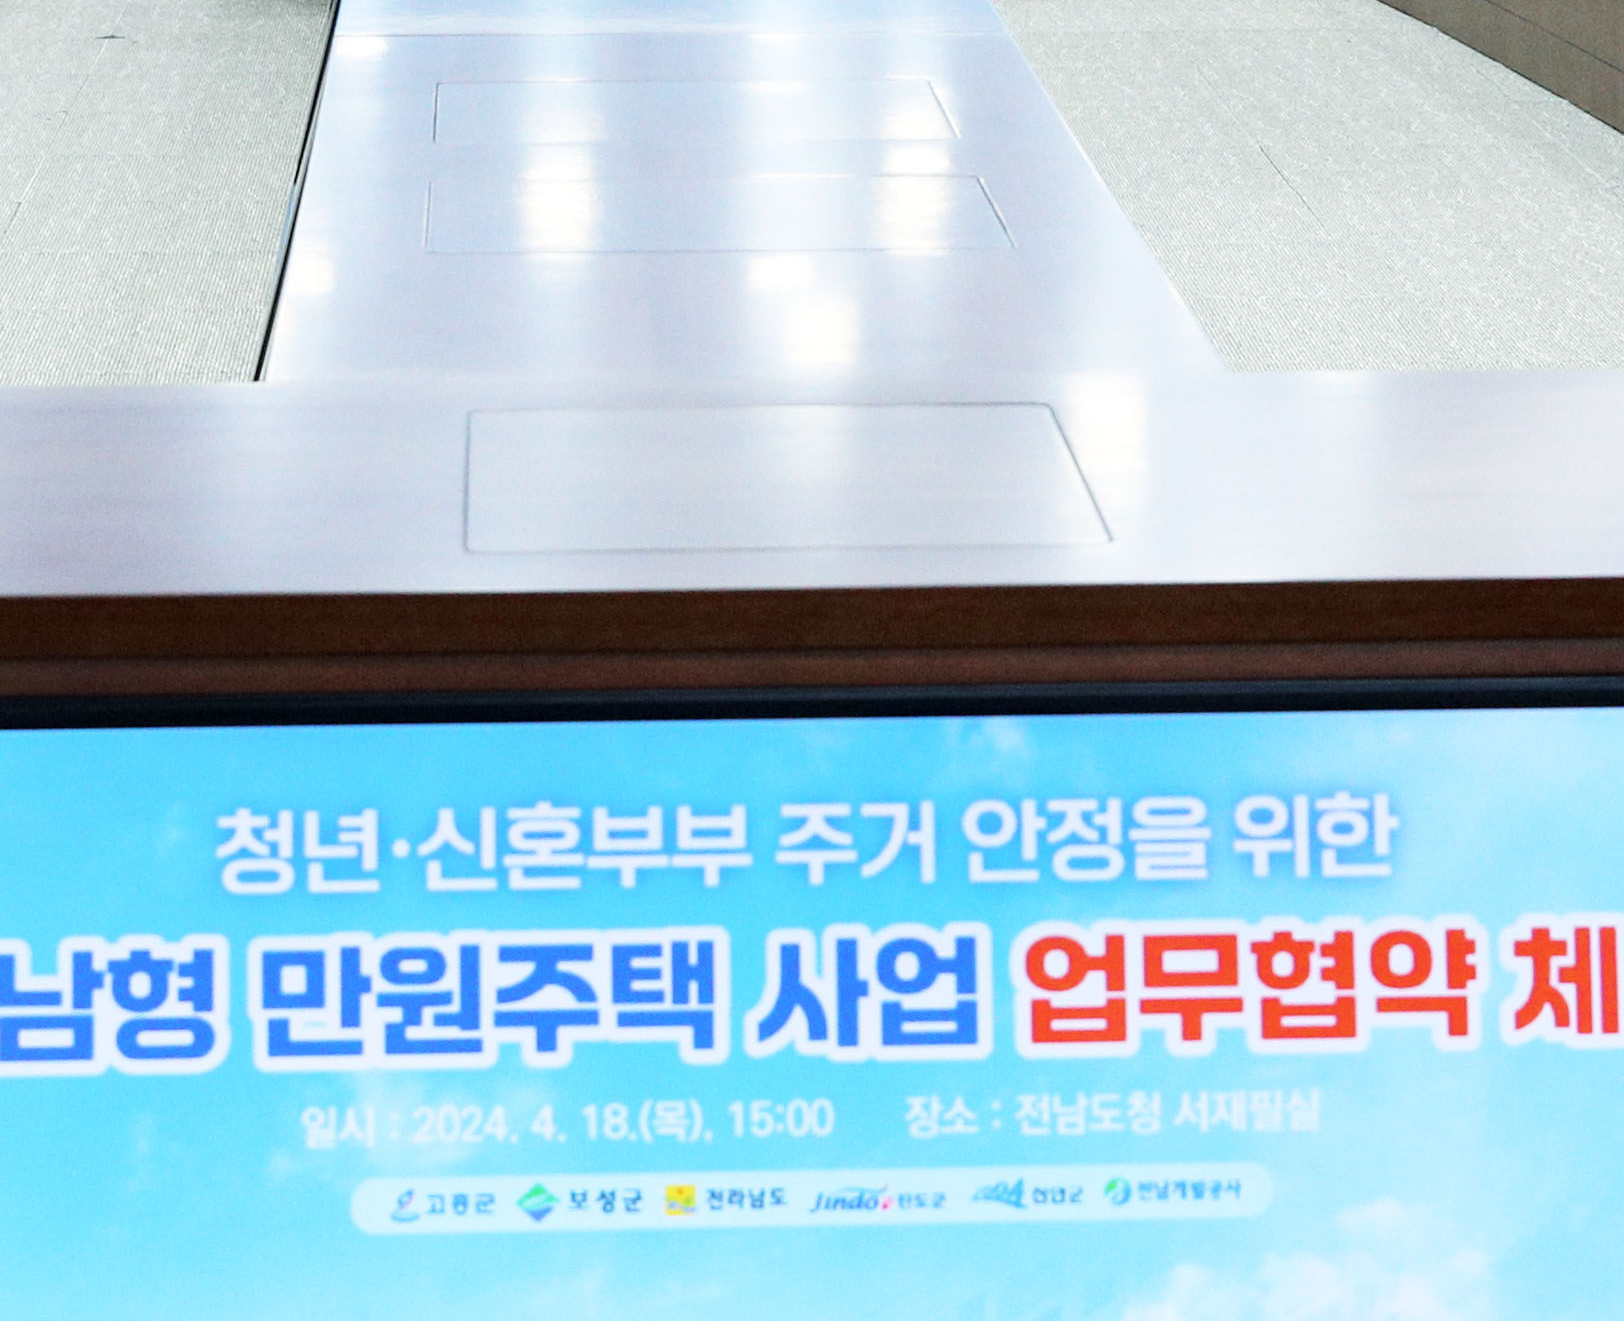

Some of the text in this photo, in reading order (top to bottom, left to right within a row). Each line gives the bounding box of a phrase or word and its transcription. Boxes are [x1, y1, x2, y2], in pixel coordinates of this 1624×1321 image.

[214, 791, 1399, 895] 청년·신혼부부 주거 안정을 위한
[259, 938, 718, 1060] 만원주택
[754, 933, 980, 1051] 사업
[1021, 924, 1478, 1045] 업무협약
[300, 1104, 376, 1151] 일시
[411, 1103, 520, 1146] 2024.
[530, 1102, 567, 1144] 4.
[727, 1097, 835, 1140] 15:00
[903, 1094, 980, 1139] 장소
[1014, 1091, 1163, 1136] 전남도청
[1172, 1088, 1321, 1134] 서재필실
[568, 1189, 643, 1214] 보성군
[706, 1186, 788, 1210] 전라남도
[808, 1185, 885, 1215] Jindo
